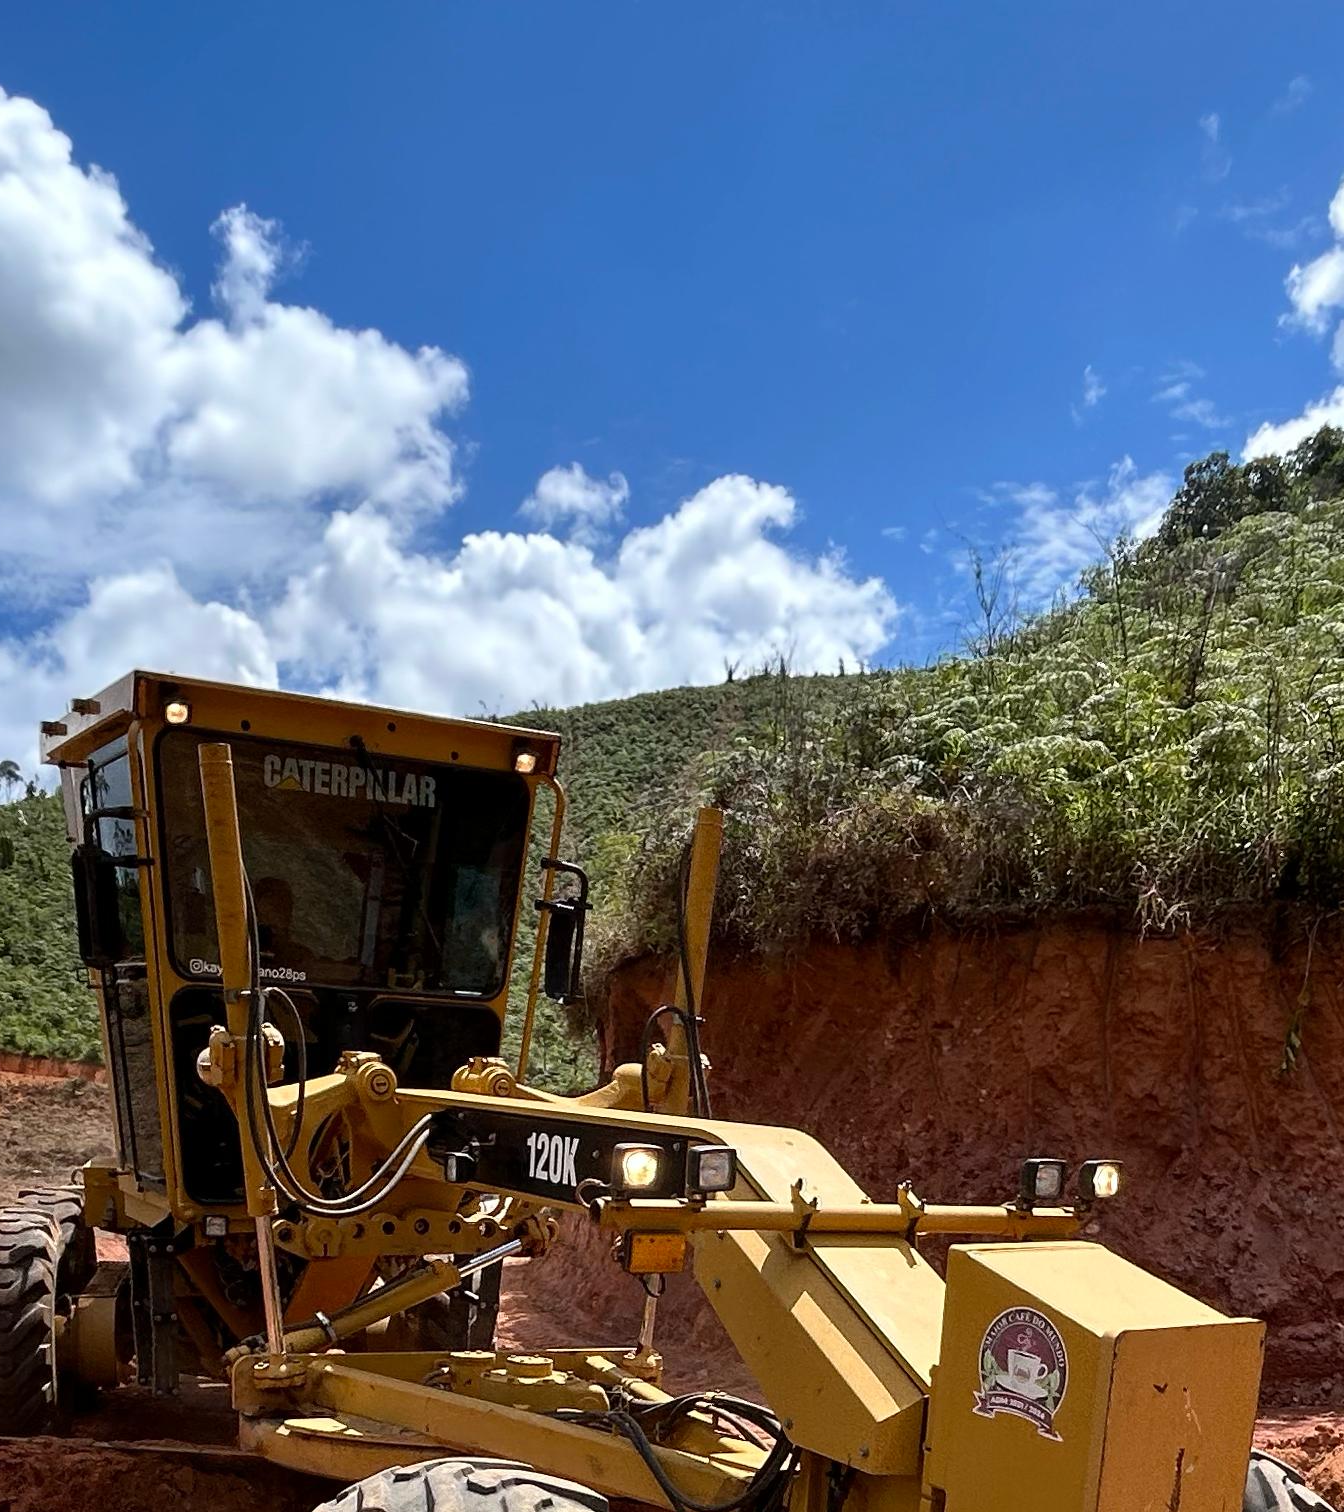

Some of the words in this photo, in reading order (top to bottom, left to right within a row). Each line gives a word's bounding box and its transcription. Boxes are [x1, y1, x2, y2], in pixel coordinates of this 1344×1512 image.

[264, 754, 436, 808] CATERPILLAR
[527, 1131, 579, 1187] 120K
[986, 1318, 1008, 1345] MAIOR
[1033, 1316, 1045, 1328] DO
[1046, 1327, 1064, 1367] MUNDO
